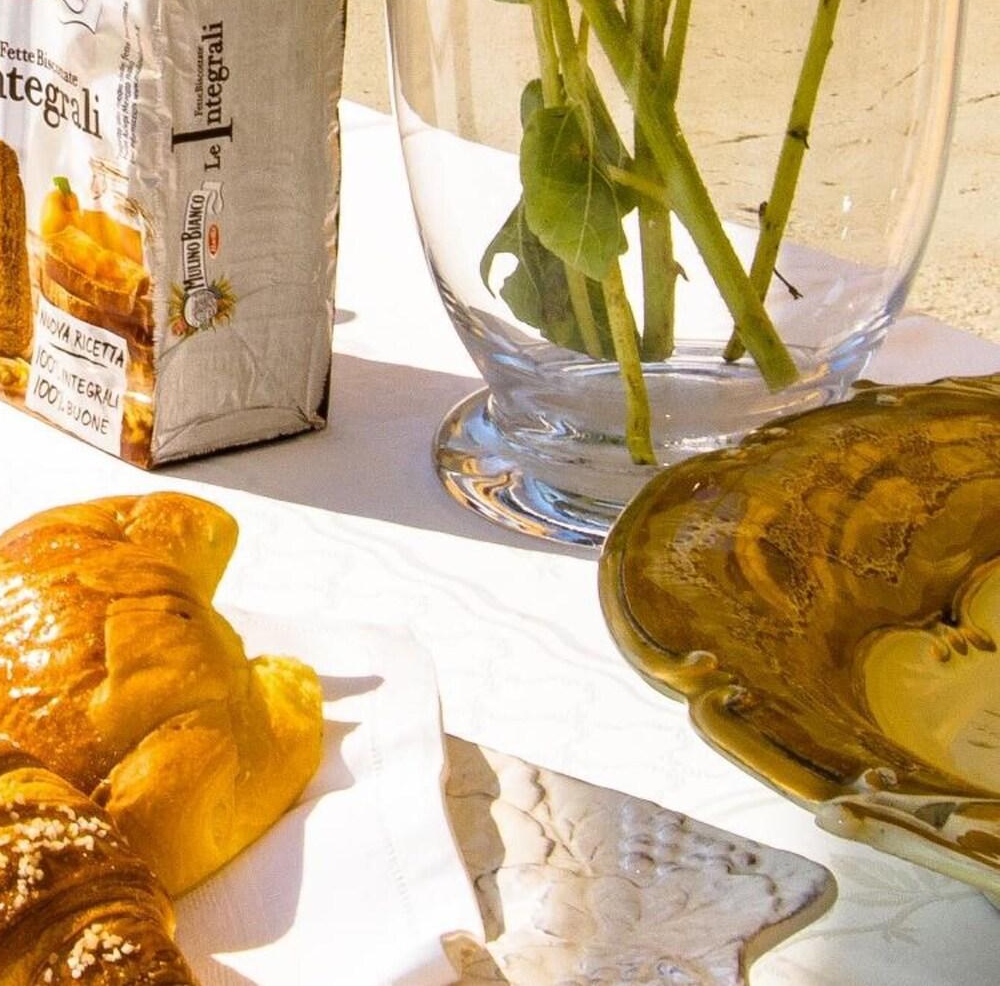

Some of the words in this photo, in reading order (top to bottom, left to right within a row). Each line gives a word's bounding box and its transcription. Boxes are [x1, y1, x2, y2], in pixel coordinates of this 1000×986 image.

[0, 41, 35, 63] Fette
[171, 20, 233, 153] Integrali
[204, 143, 221, 171] Le
[181, 194, 206, 242] BIANCO
[183, 243, 205, 293] MULINO
[74, 329, 124, 368] RICETTA
